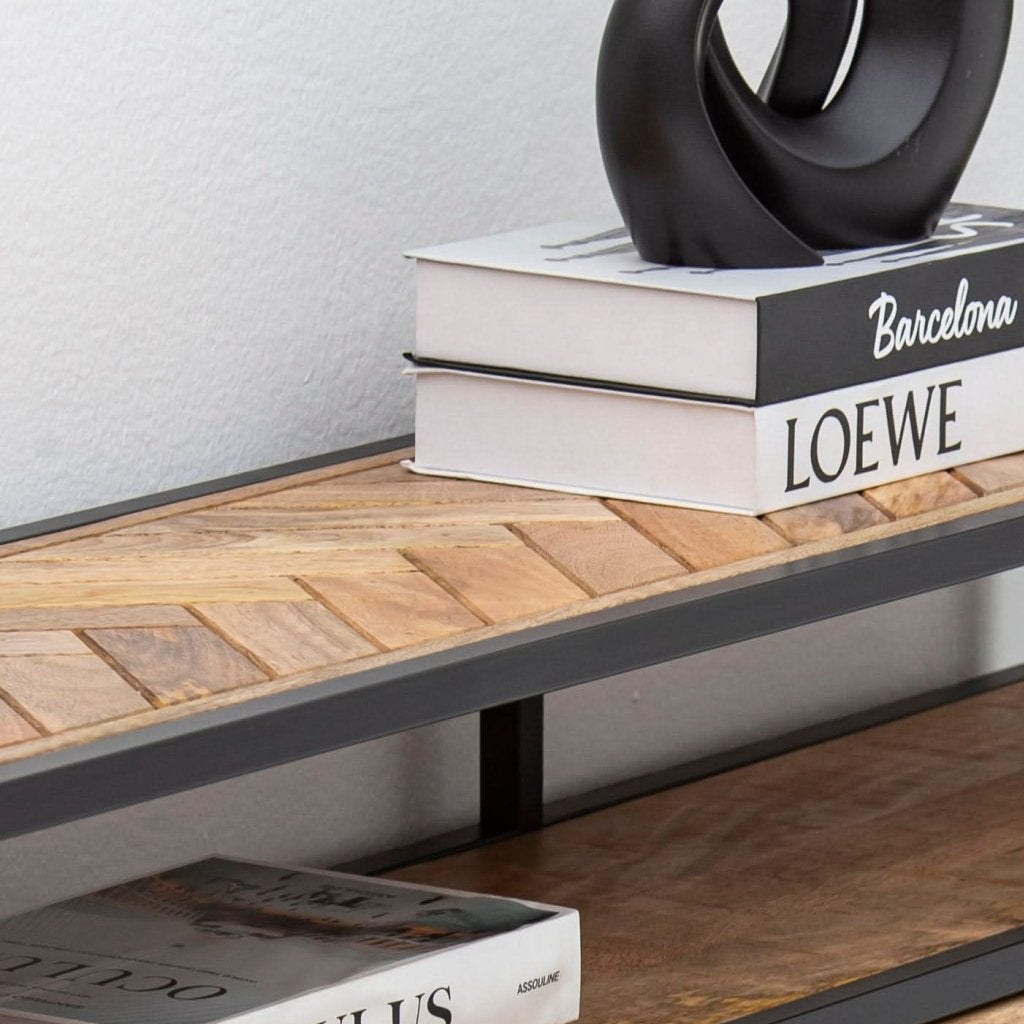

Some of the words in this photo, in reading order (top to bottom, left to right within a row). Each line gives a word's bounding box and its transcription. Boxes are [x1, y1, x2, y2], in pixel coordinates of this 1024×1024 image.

[868, 277, 1018, 359] Barcelona
[784, 379, 963, 493] LOEWE
[517, 970, 560, 995] ASSOULINE
